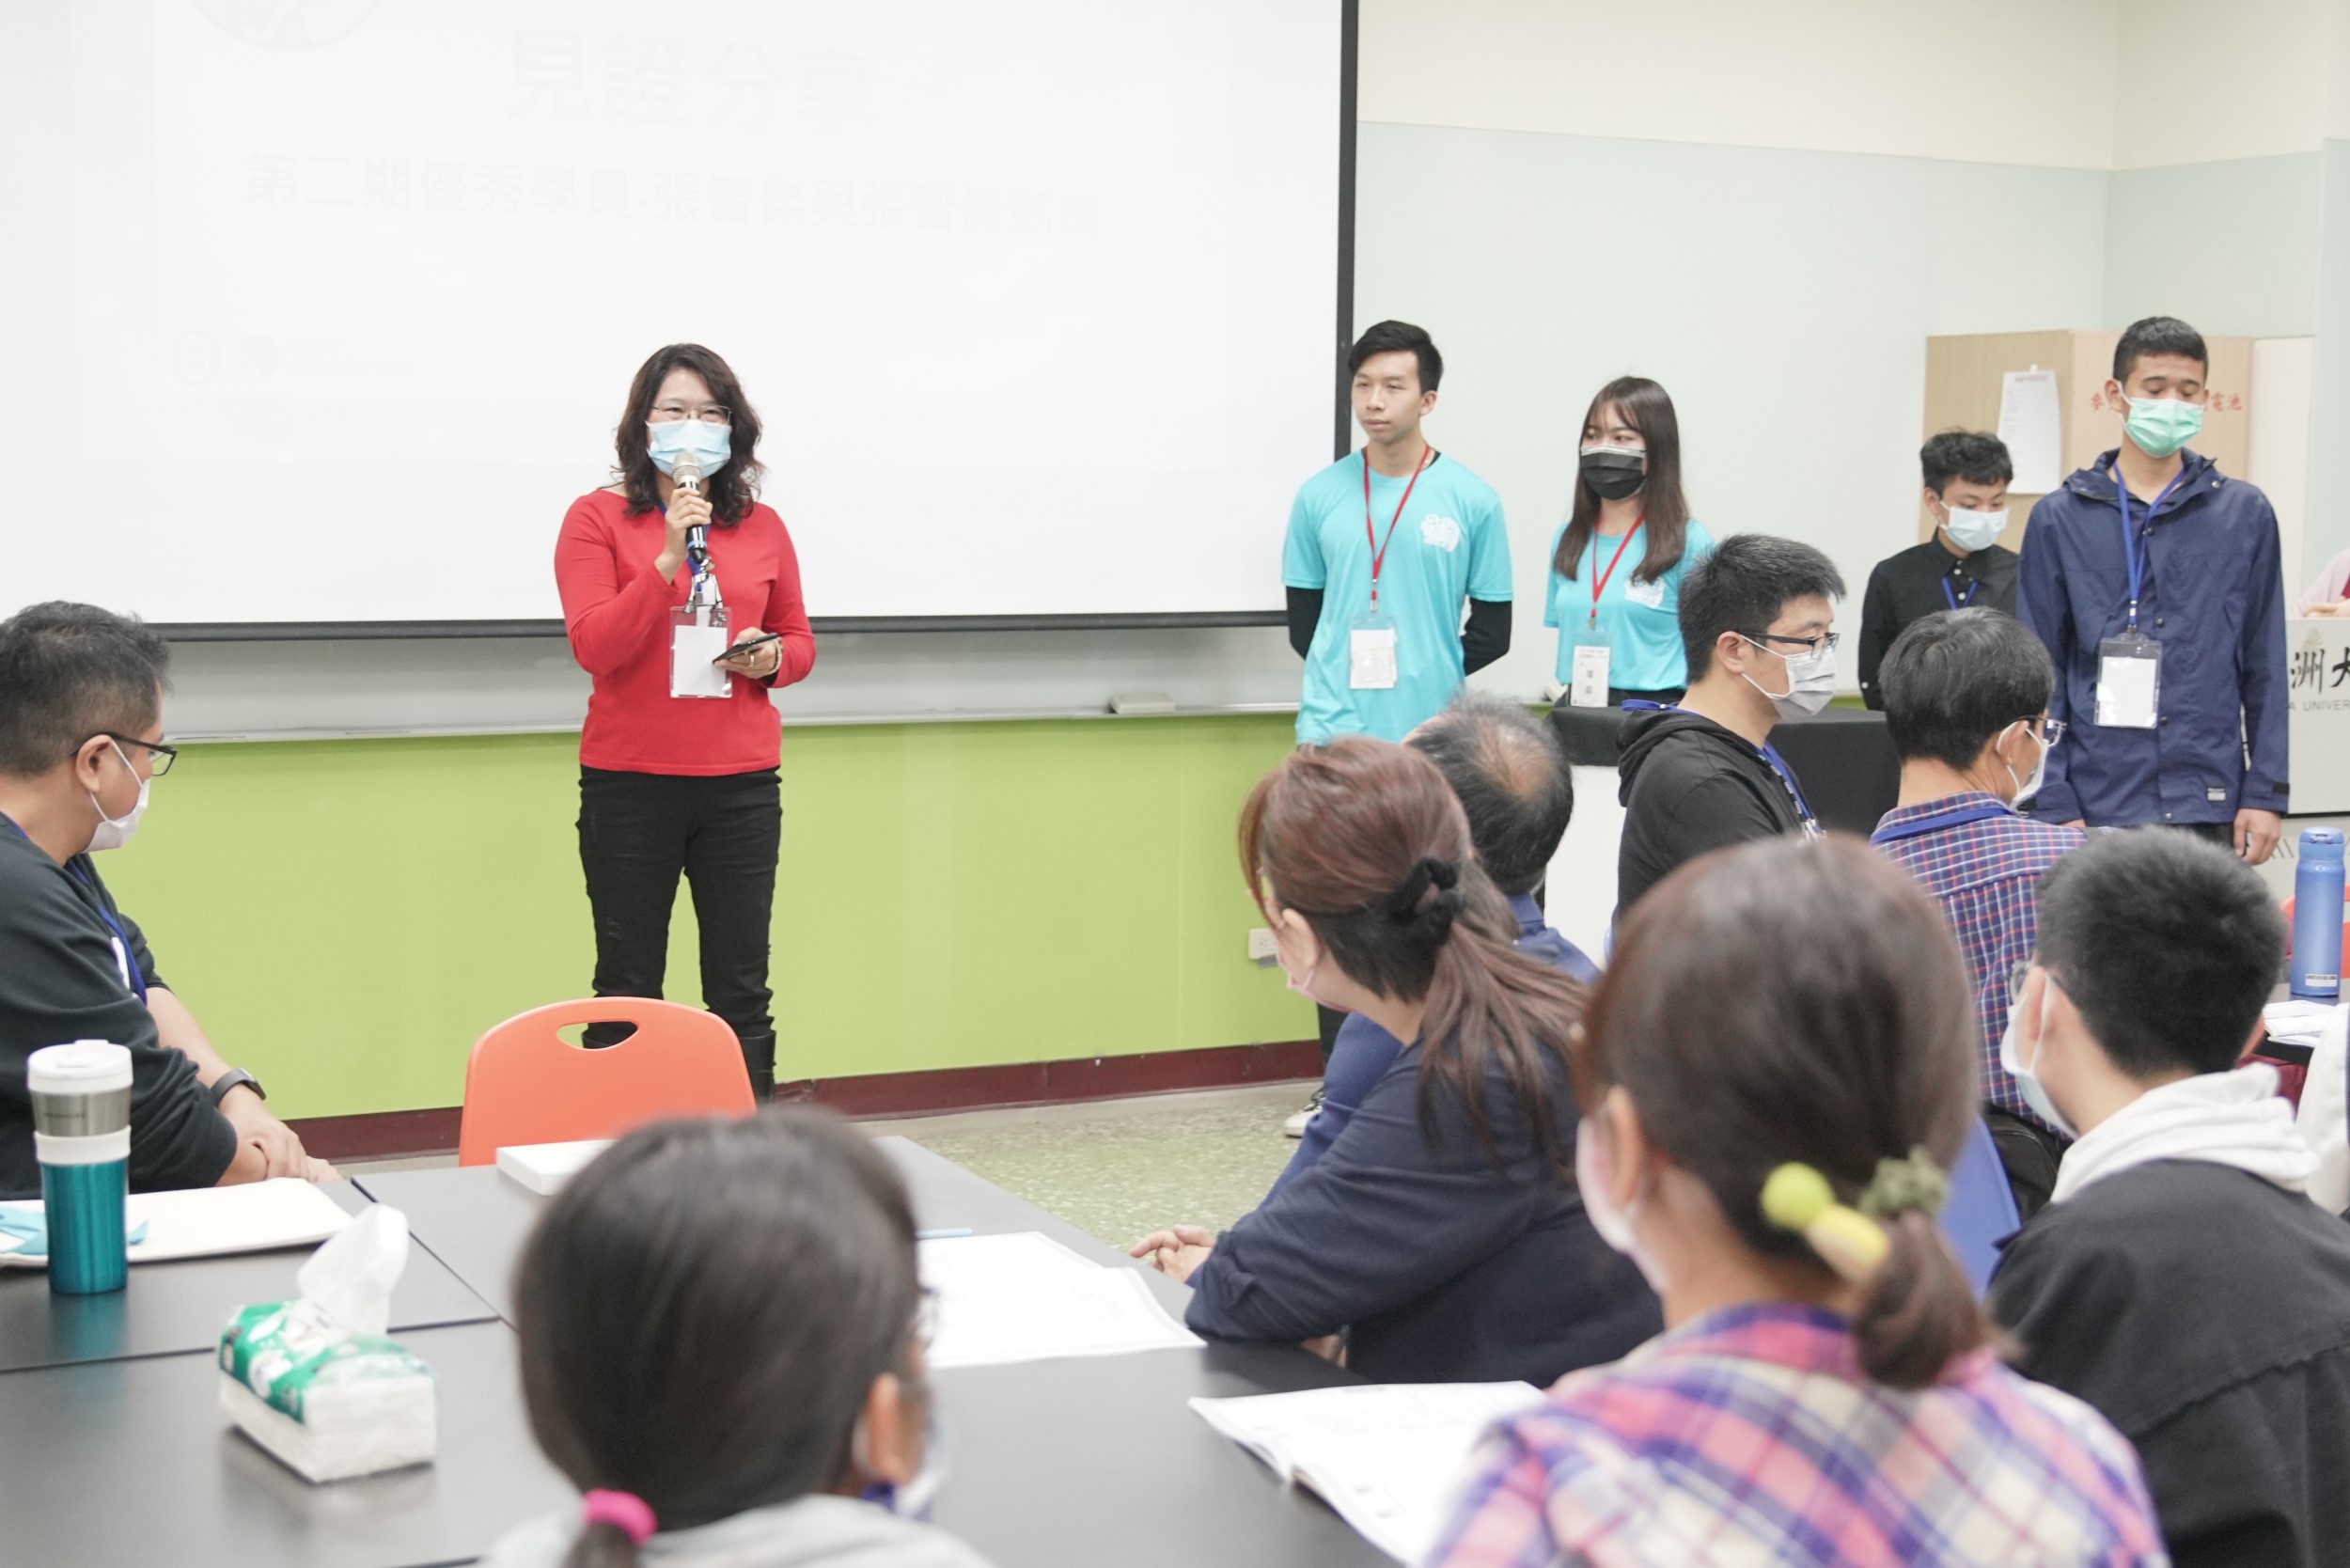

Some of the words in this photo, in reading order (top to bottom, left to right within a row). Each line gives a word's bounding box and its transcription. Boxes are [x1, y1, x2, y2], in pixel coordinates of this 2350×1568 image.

[507, 28, 878, 134] 見證分享
[244, 150, 1102, 238] 第二期優秀學員-張智傑與張智傑媽媽
